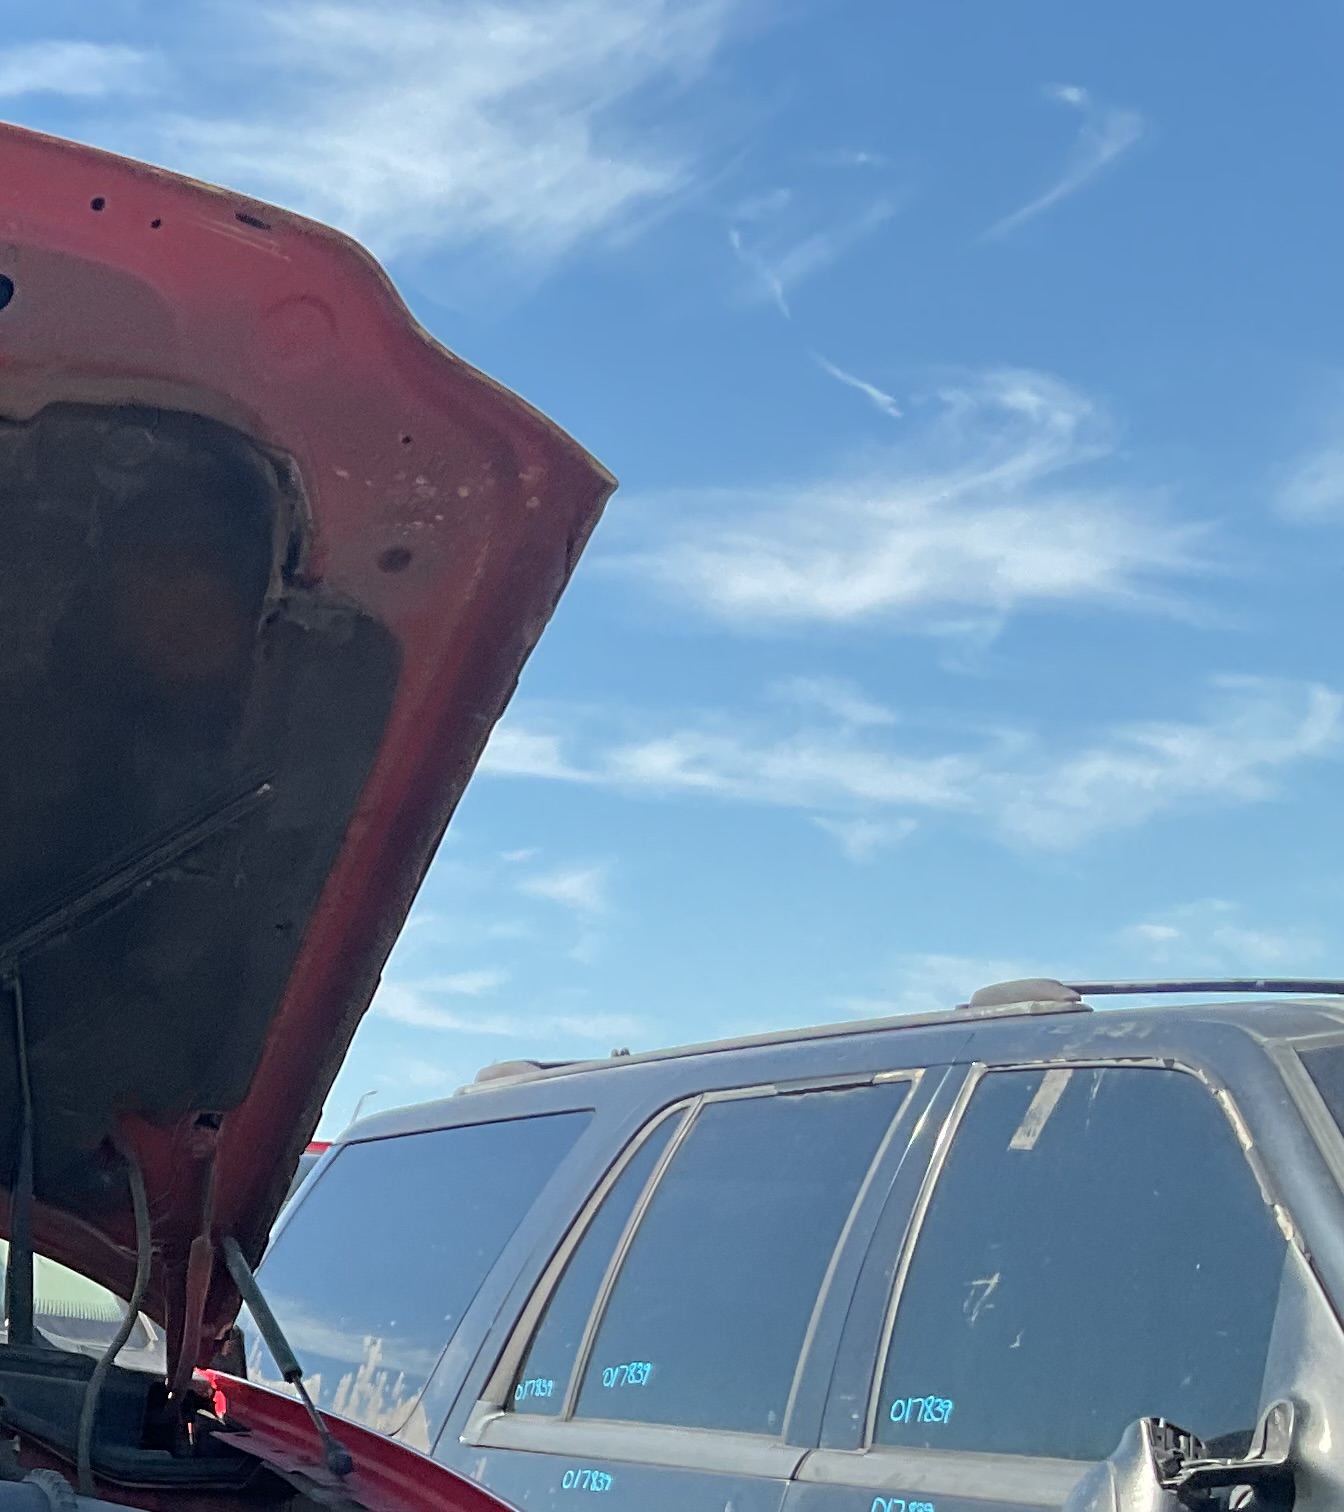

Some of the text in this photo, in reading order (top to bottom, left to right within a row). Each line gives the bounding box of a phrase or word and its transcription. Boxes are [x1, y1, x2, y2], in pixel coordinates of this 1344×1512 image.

[602, 1361, 653, 1388] 017839
[514, 1377, 554, 1401] 017839
[889, 1395, 954, 1424] 017839
